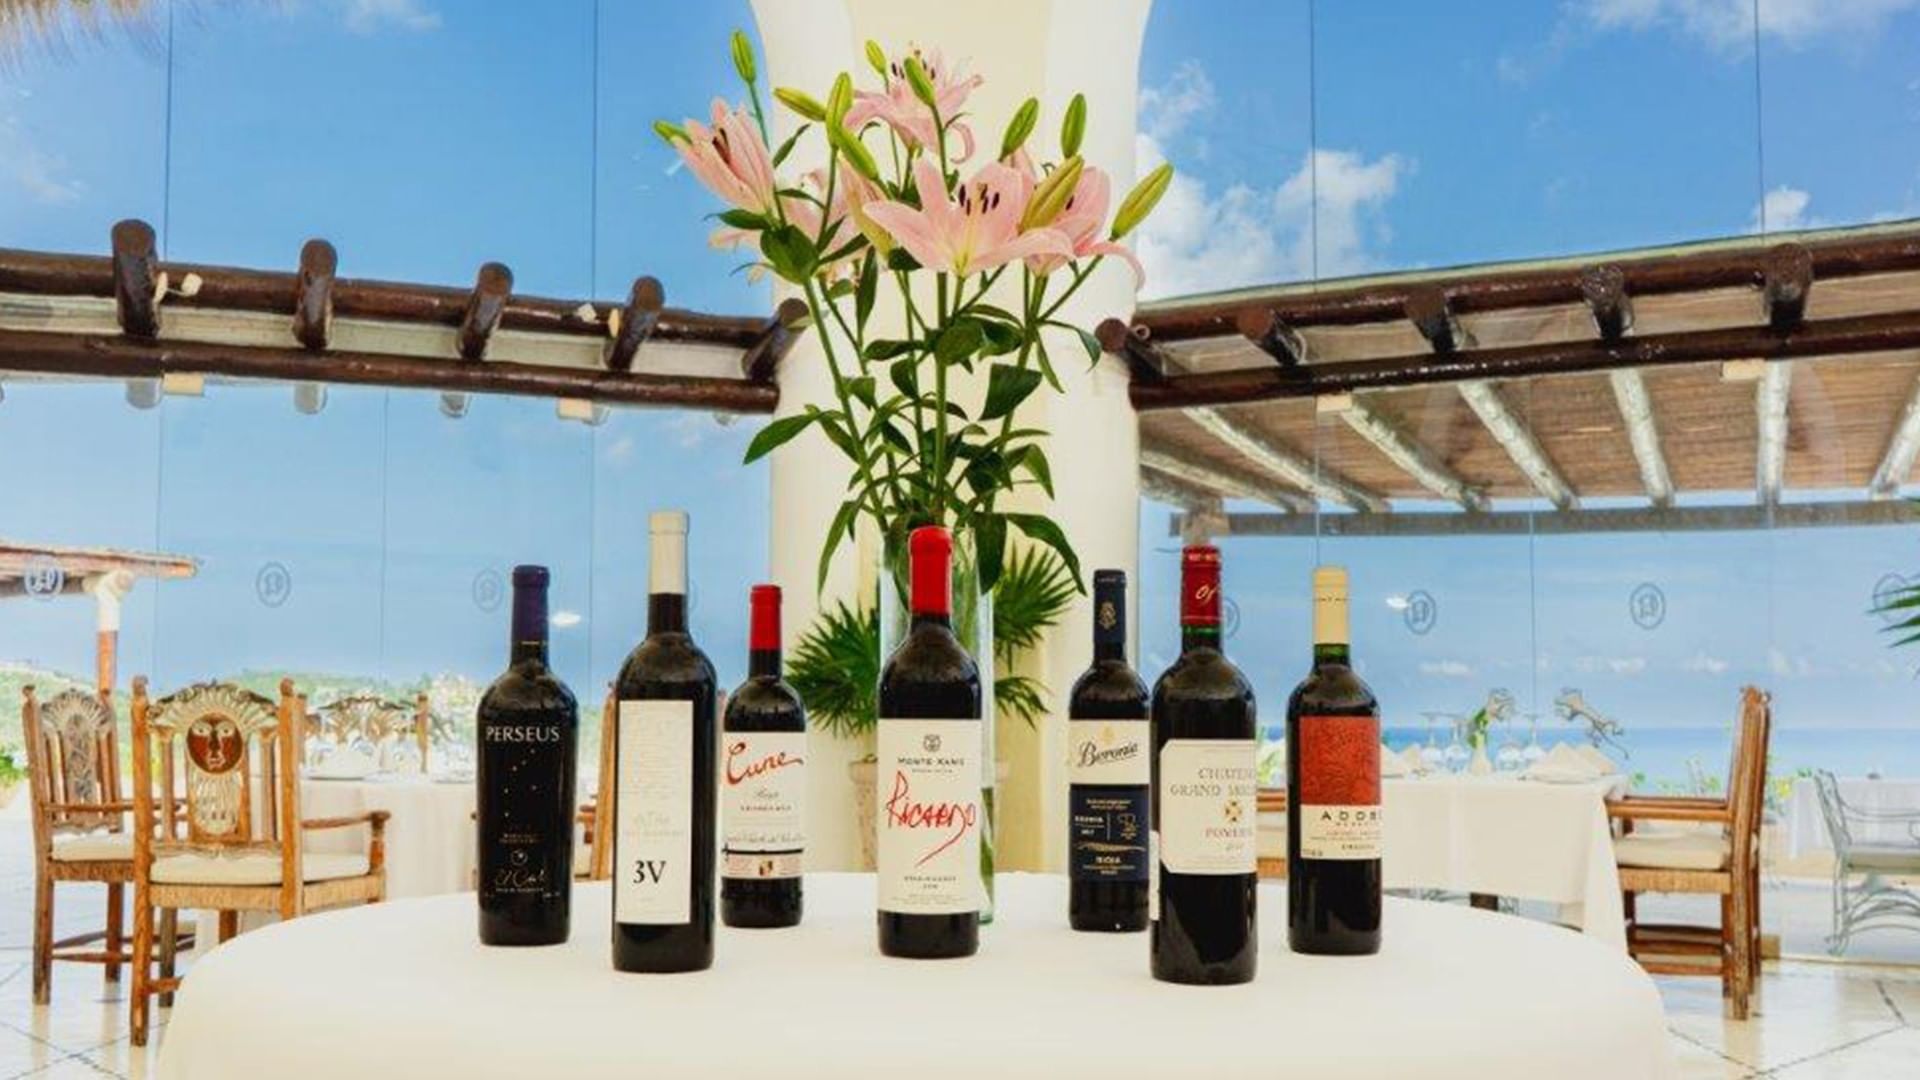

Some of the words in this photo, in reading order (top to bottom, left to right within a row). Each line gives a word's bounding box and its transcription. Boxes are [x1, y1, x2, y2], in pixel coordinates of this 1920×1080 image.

[486, 726, 560, 742] PERSEUS
[727, 742, 804, 785] Cune
[632, 860, 667, 885] 3V
